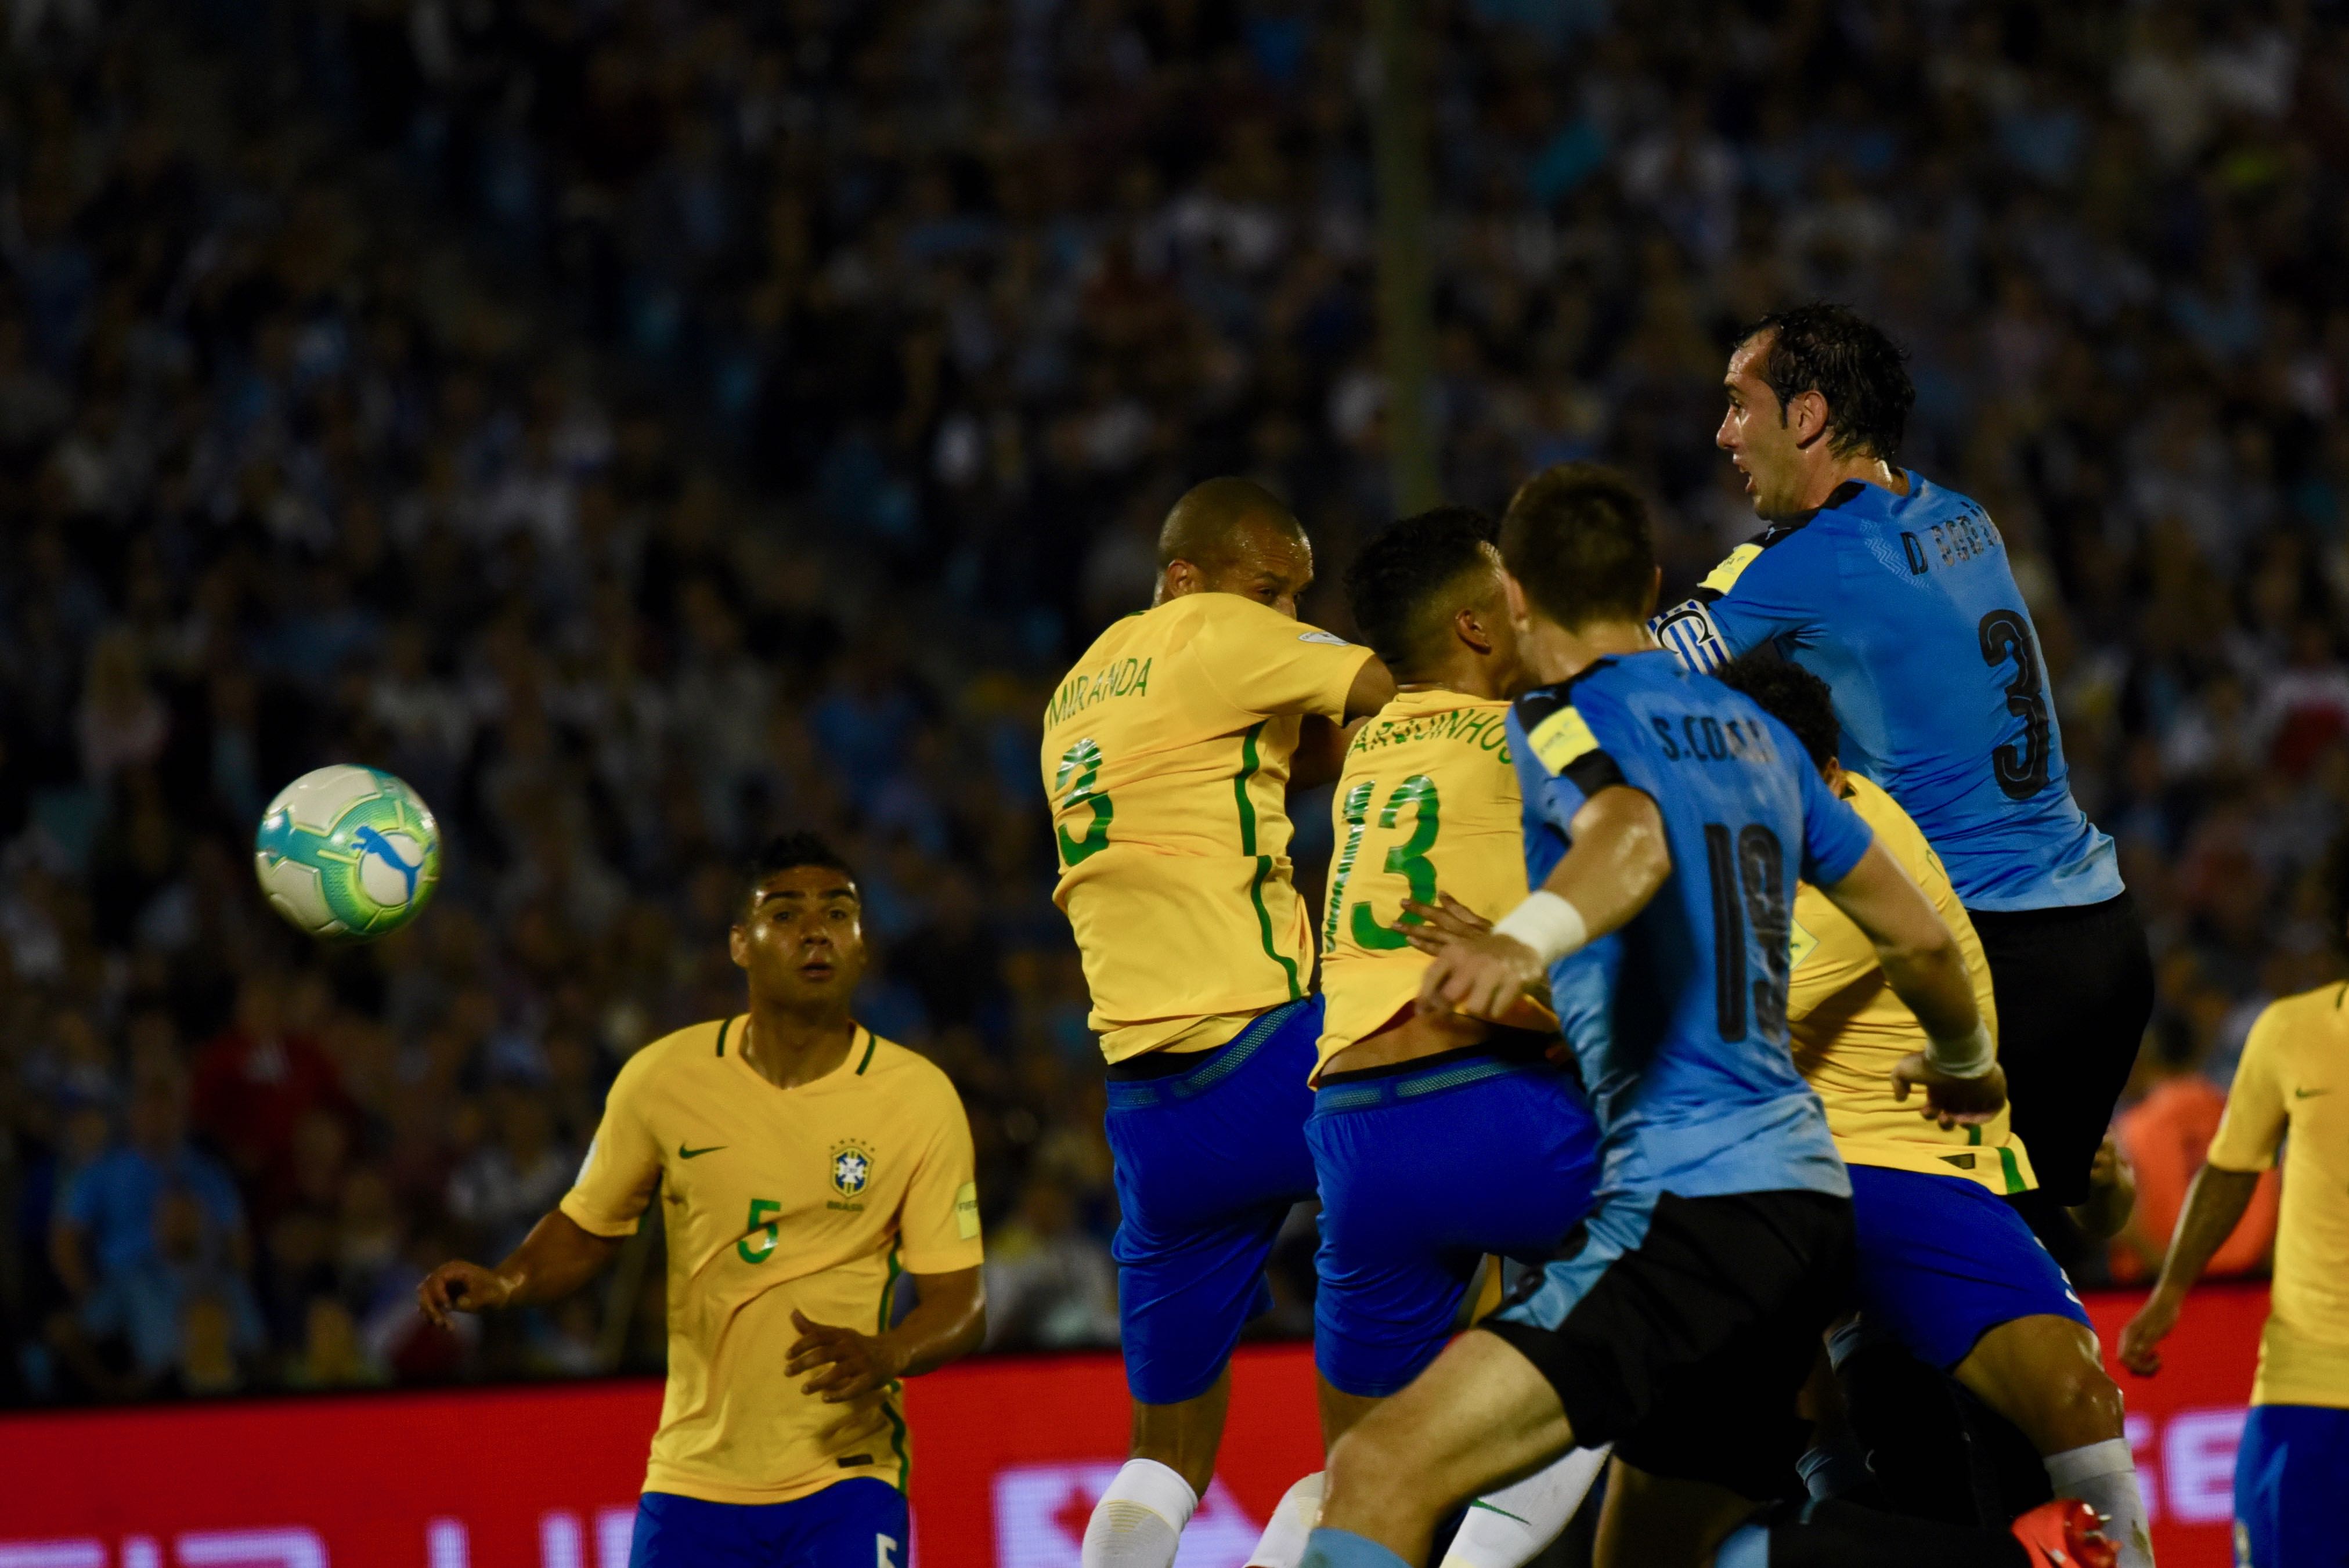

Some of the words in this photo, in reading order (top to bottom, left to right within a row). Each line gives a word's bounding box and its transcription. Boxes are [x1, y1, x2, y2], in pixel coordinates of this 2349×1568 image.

[1049, 657, 1152, 731] MIRANDA
[1347, 709, 1513, 764] ARQUINHO
[1979, 609, 2048, 799] 3
[1055, 738, 1113, 867] 3
[1324, 775, 1440, 950] 13
[738, 1199, 781, 1263] 5
